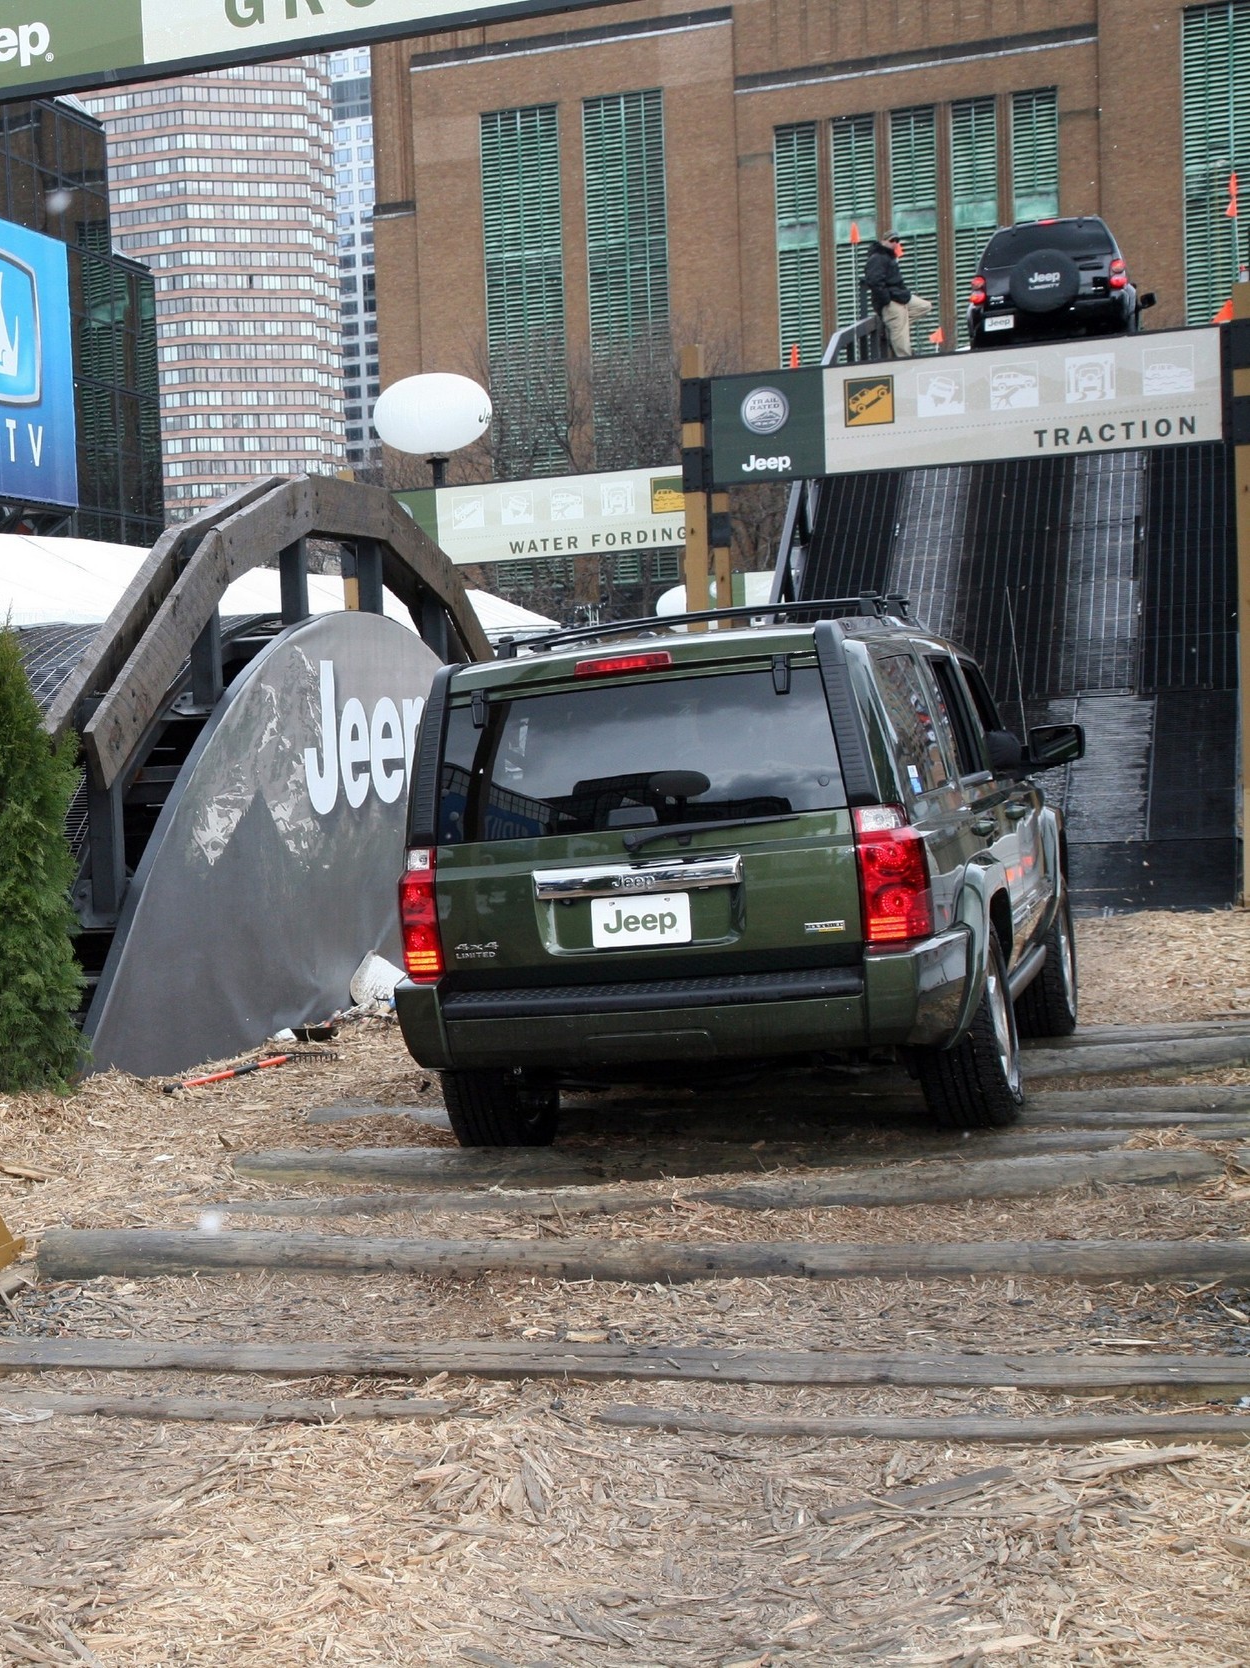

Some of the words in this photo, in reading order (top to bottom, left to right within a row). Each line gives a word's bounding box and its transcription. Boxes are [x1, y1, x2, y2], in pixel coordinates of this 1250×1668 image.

[1028, 272, 1060, 283] Jeep
[988, 319, 1011, 328] Jeep
[1033, 415, 1196, 448] TRACTION
[5, 418, 44, 468] TV
[509, 535, 579, 555] WATER
[591, 526, 686, 548] FORDING
[612, 875, 655, 890] Jeep
[454, 951, 497, 960] LIMITED
